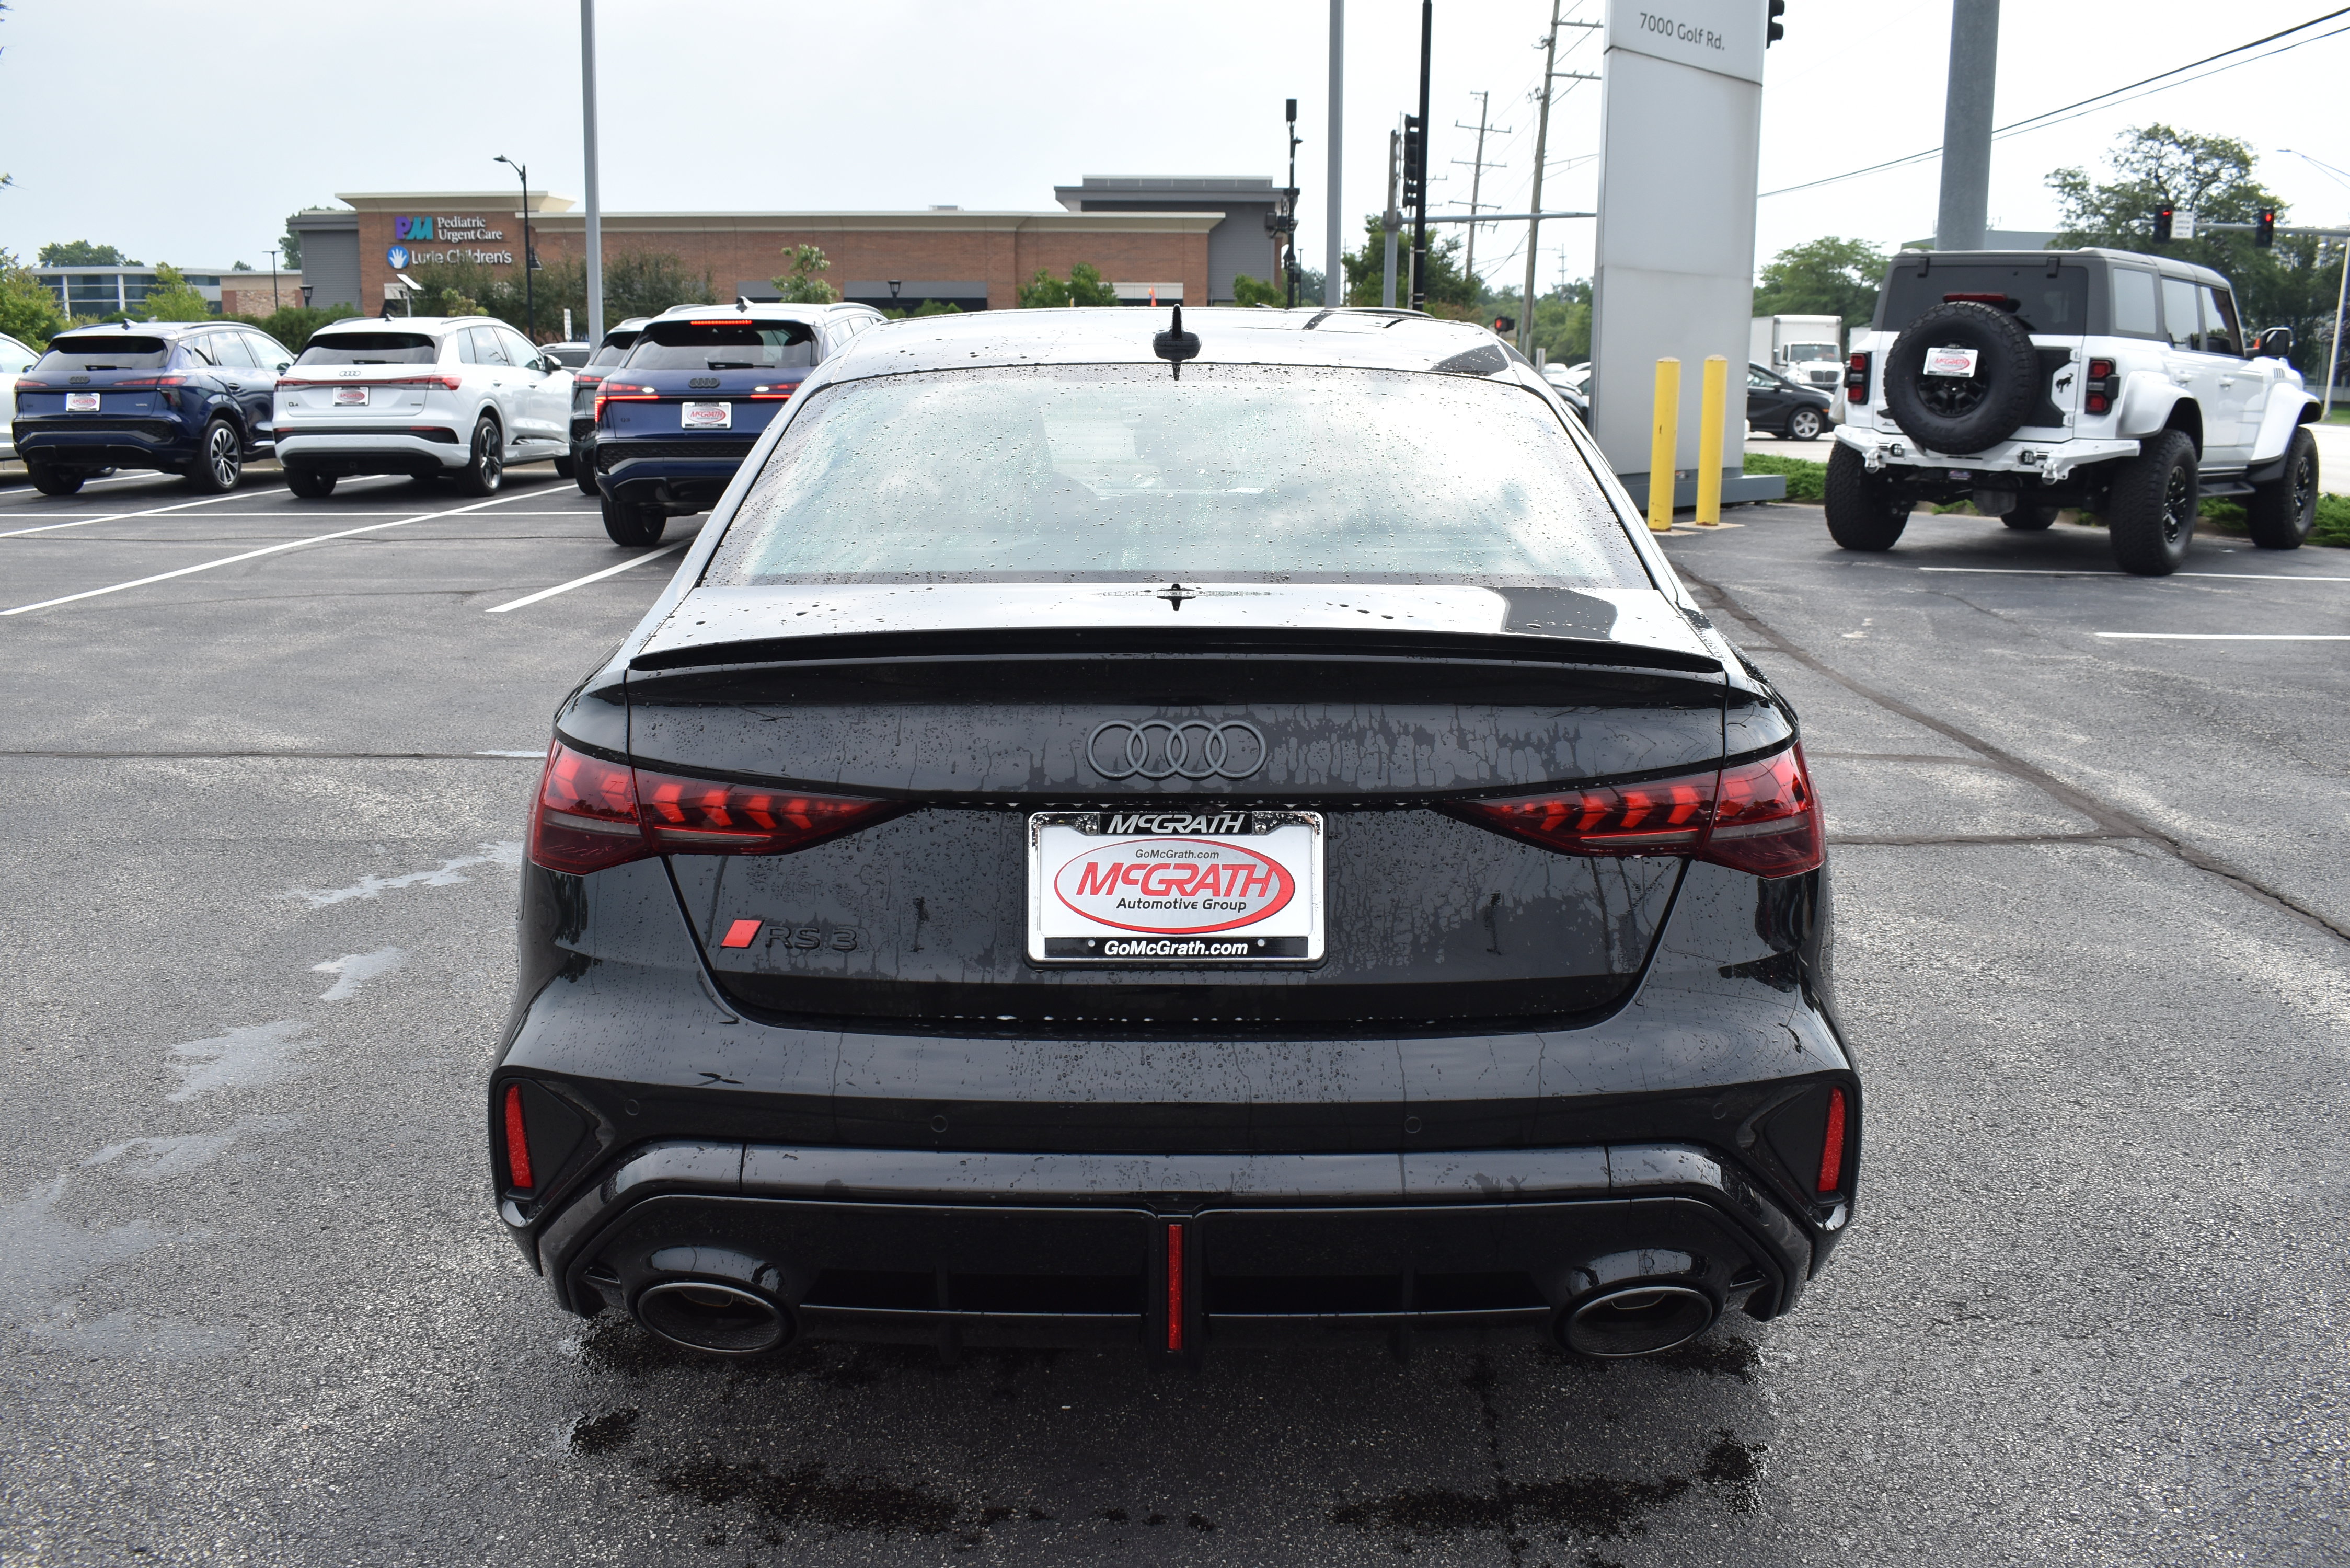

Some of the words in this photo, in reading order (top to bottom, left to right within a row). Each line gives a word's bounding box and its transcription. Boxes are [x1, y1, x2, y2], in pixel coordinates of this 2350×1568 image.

[1640, 12, 1673, 36] 7000
[1677, 23, 1704, 44] Golf
[1706, 30, 1724, 51] Rd.
[395, 216, 433, 240] PM
[437, 216, 486, 228] Pediatric
[438, 229, 476, 243] Urgent
[476, 228, 503, 240] Care
[411, 250, 444, 264] Lurie
[447, 248, 512, 264] Children's
[1135, 849, 1219, 859] GoMcGrath.com
[1116, 897, 1198, 910] Automotive
[1202, 898, 1247, 913] Group
[765, 925, 820, 949] RS
[832, 928, 858, 952] 3
[1104, 940, 1248, 955] GoMcGrath.com
